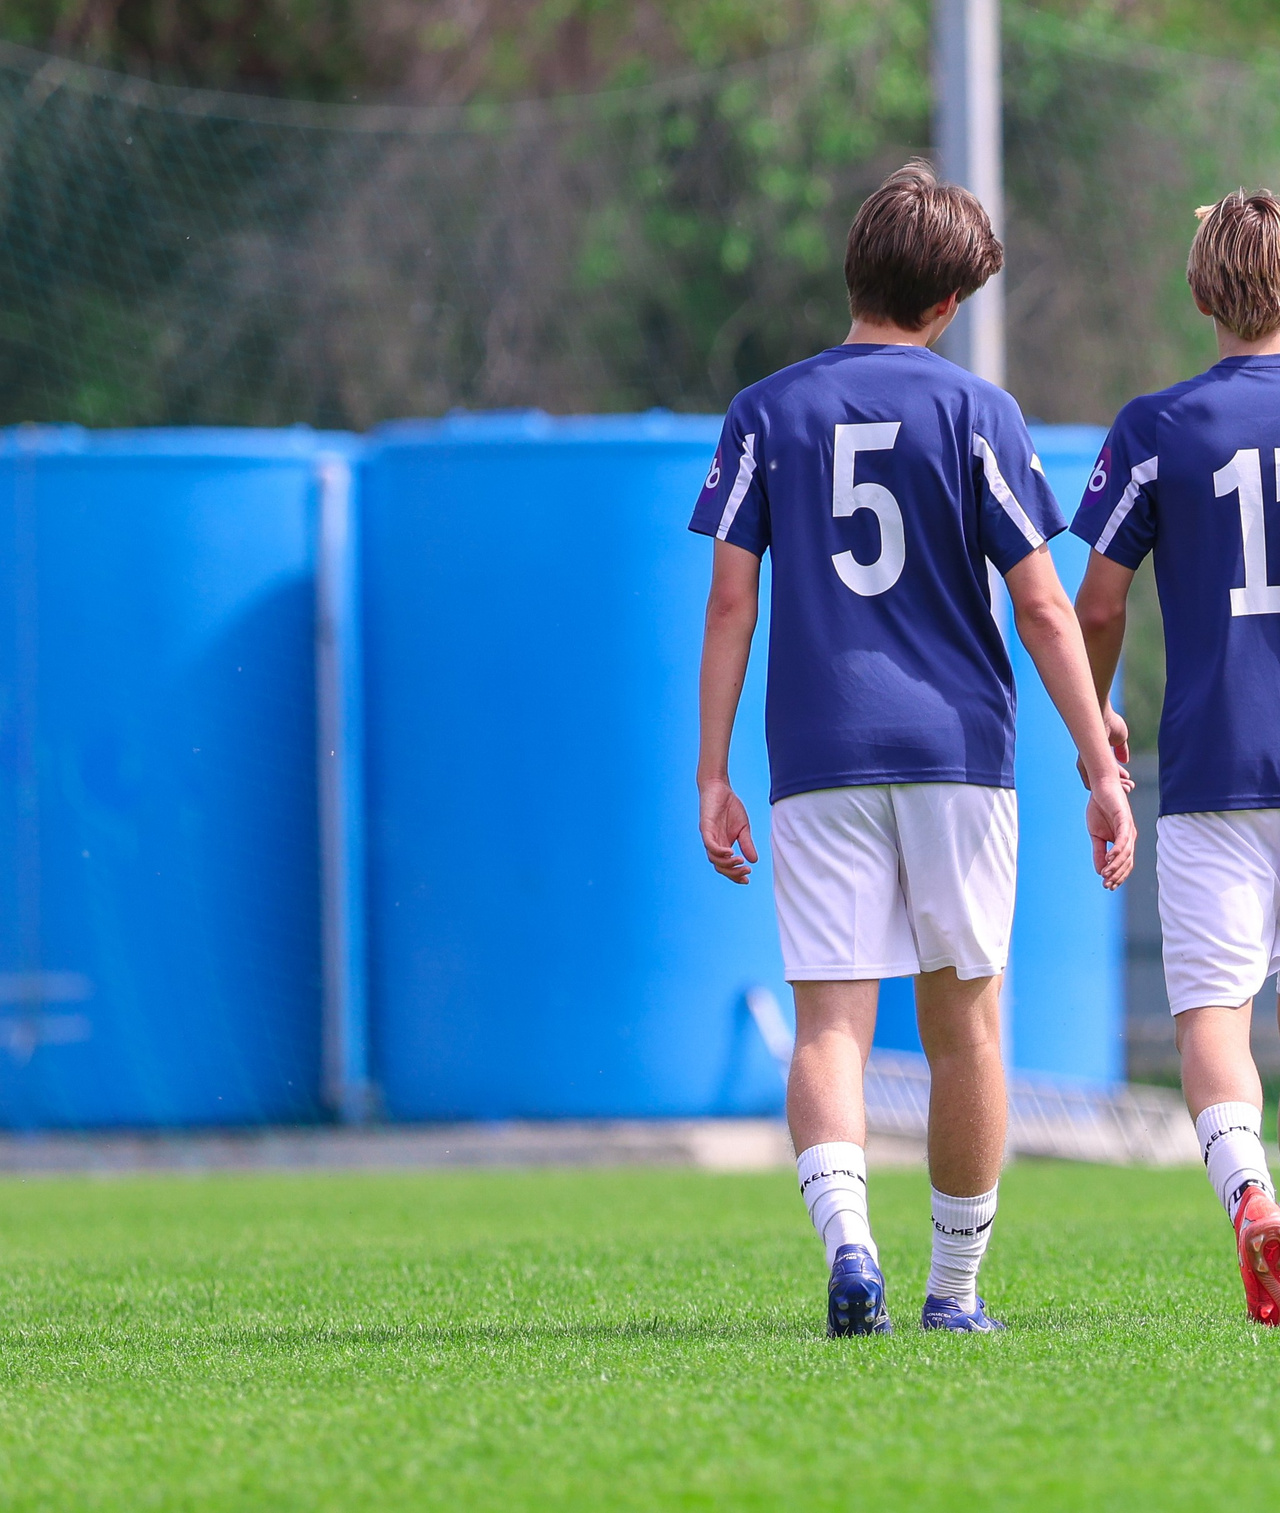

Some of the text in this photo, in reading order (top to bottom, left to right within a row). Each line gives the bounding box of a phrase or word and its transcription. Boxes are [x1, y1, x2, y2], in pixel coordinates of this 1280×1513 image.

[831, 421, 906, 598] 5
[1205, 1125, 1252, 1151] KELME
[803, 1169, 855, 1188] KELME
